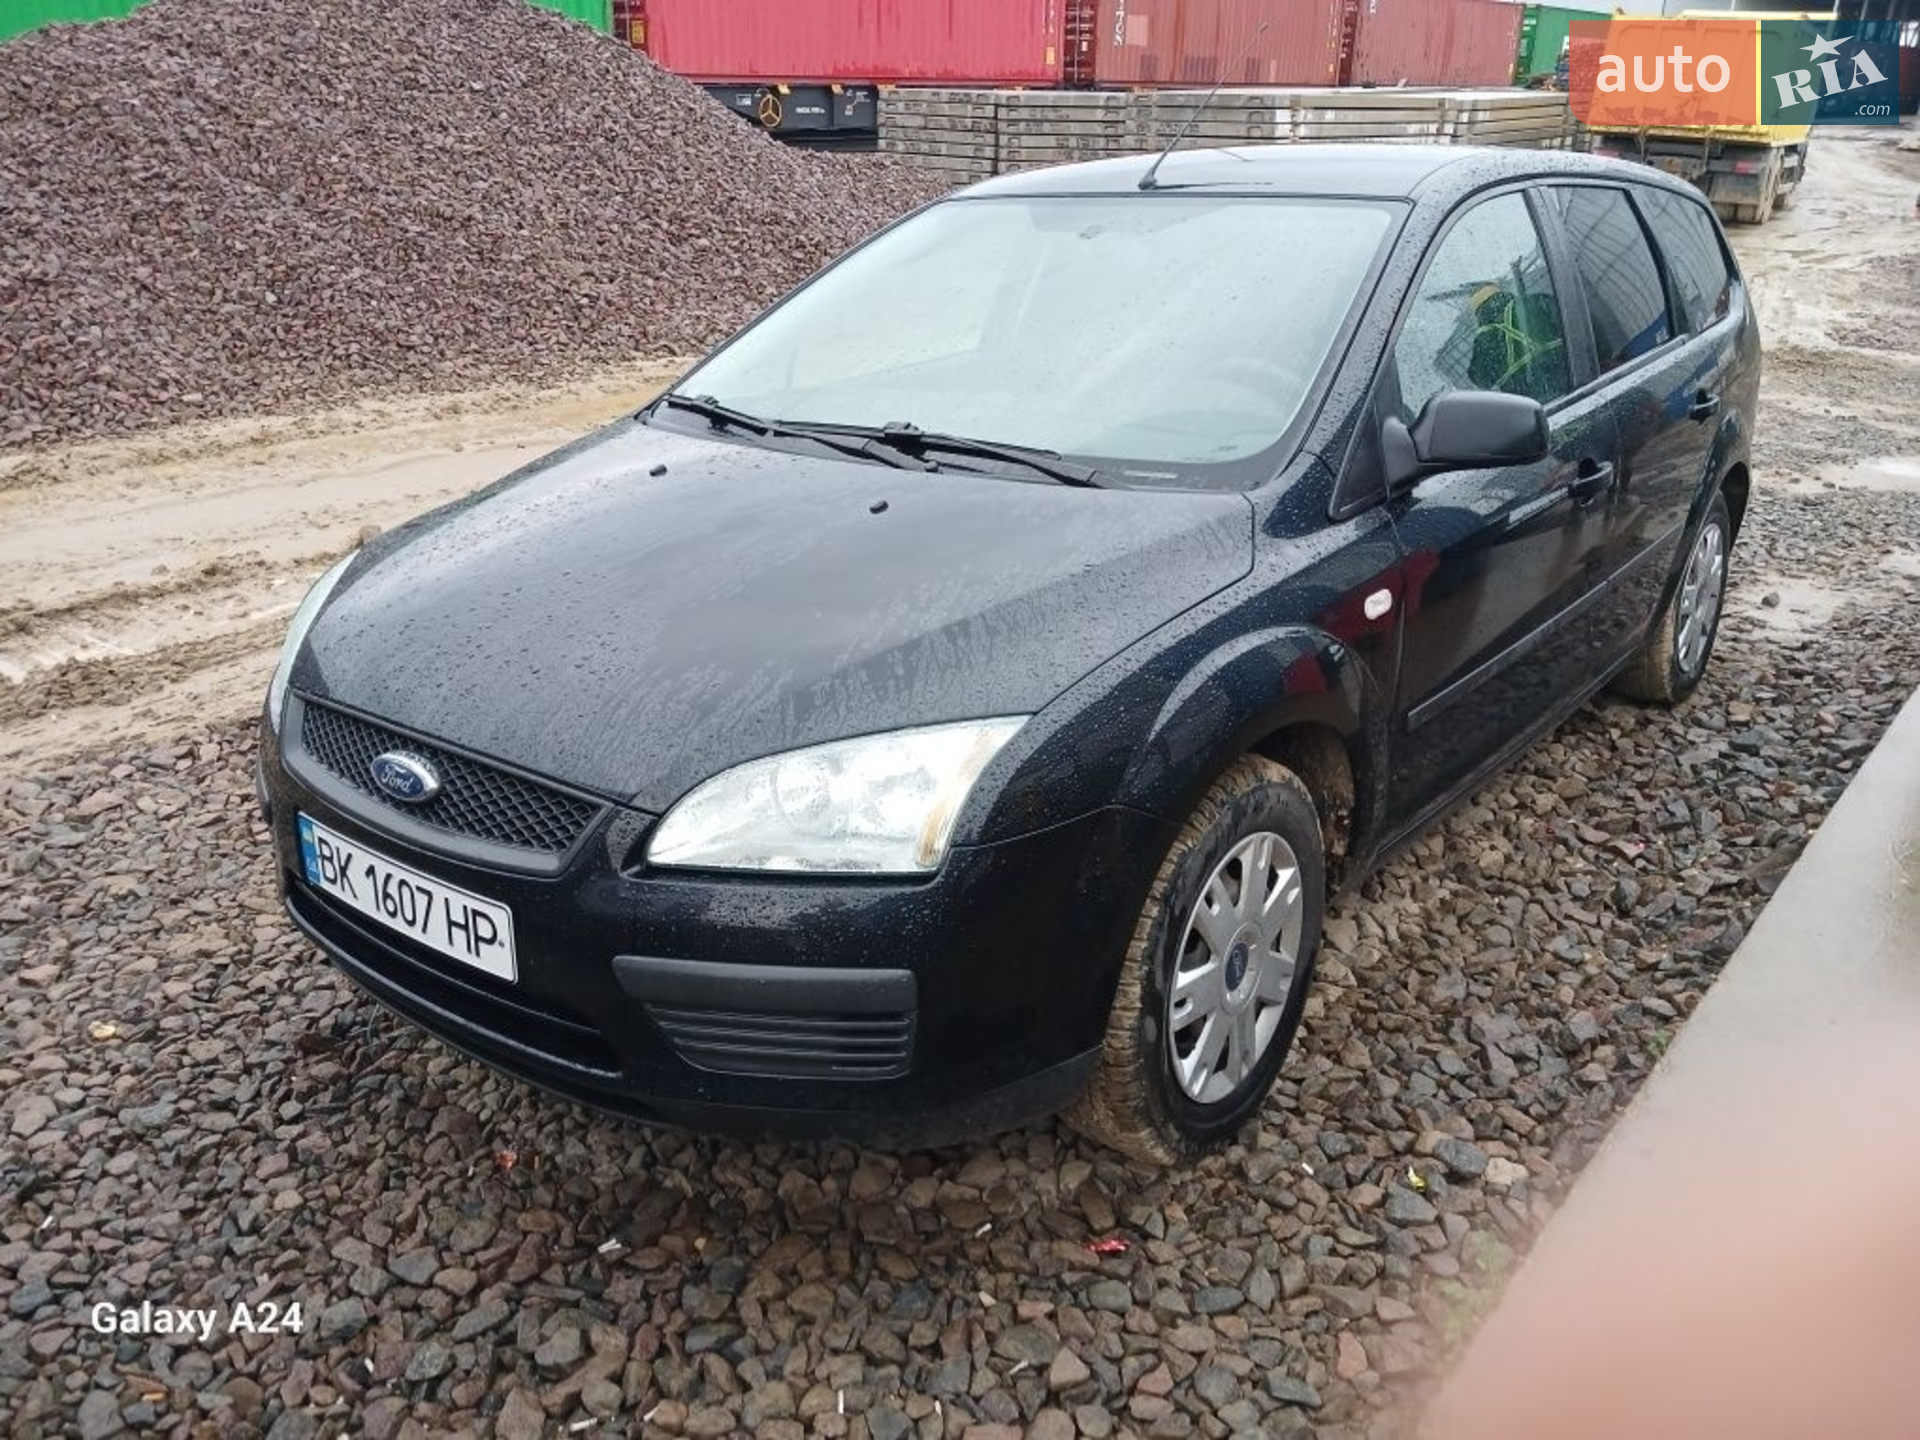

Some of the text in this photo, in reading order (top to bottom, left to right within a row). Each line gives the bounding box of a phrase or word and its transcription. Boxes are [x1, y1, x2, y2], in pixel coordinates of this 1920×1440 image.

[380, 763, 415, 794] Ford
[317, 835, 499, 958] BK 1607 HP
